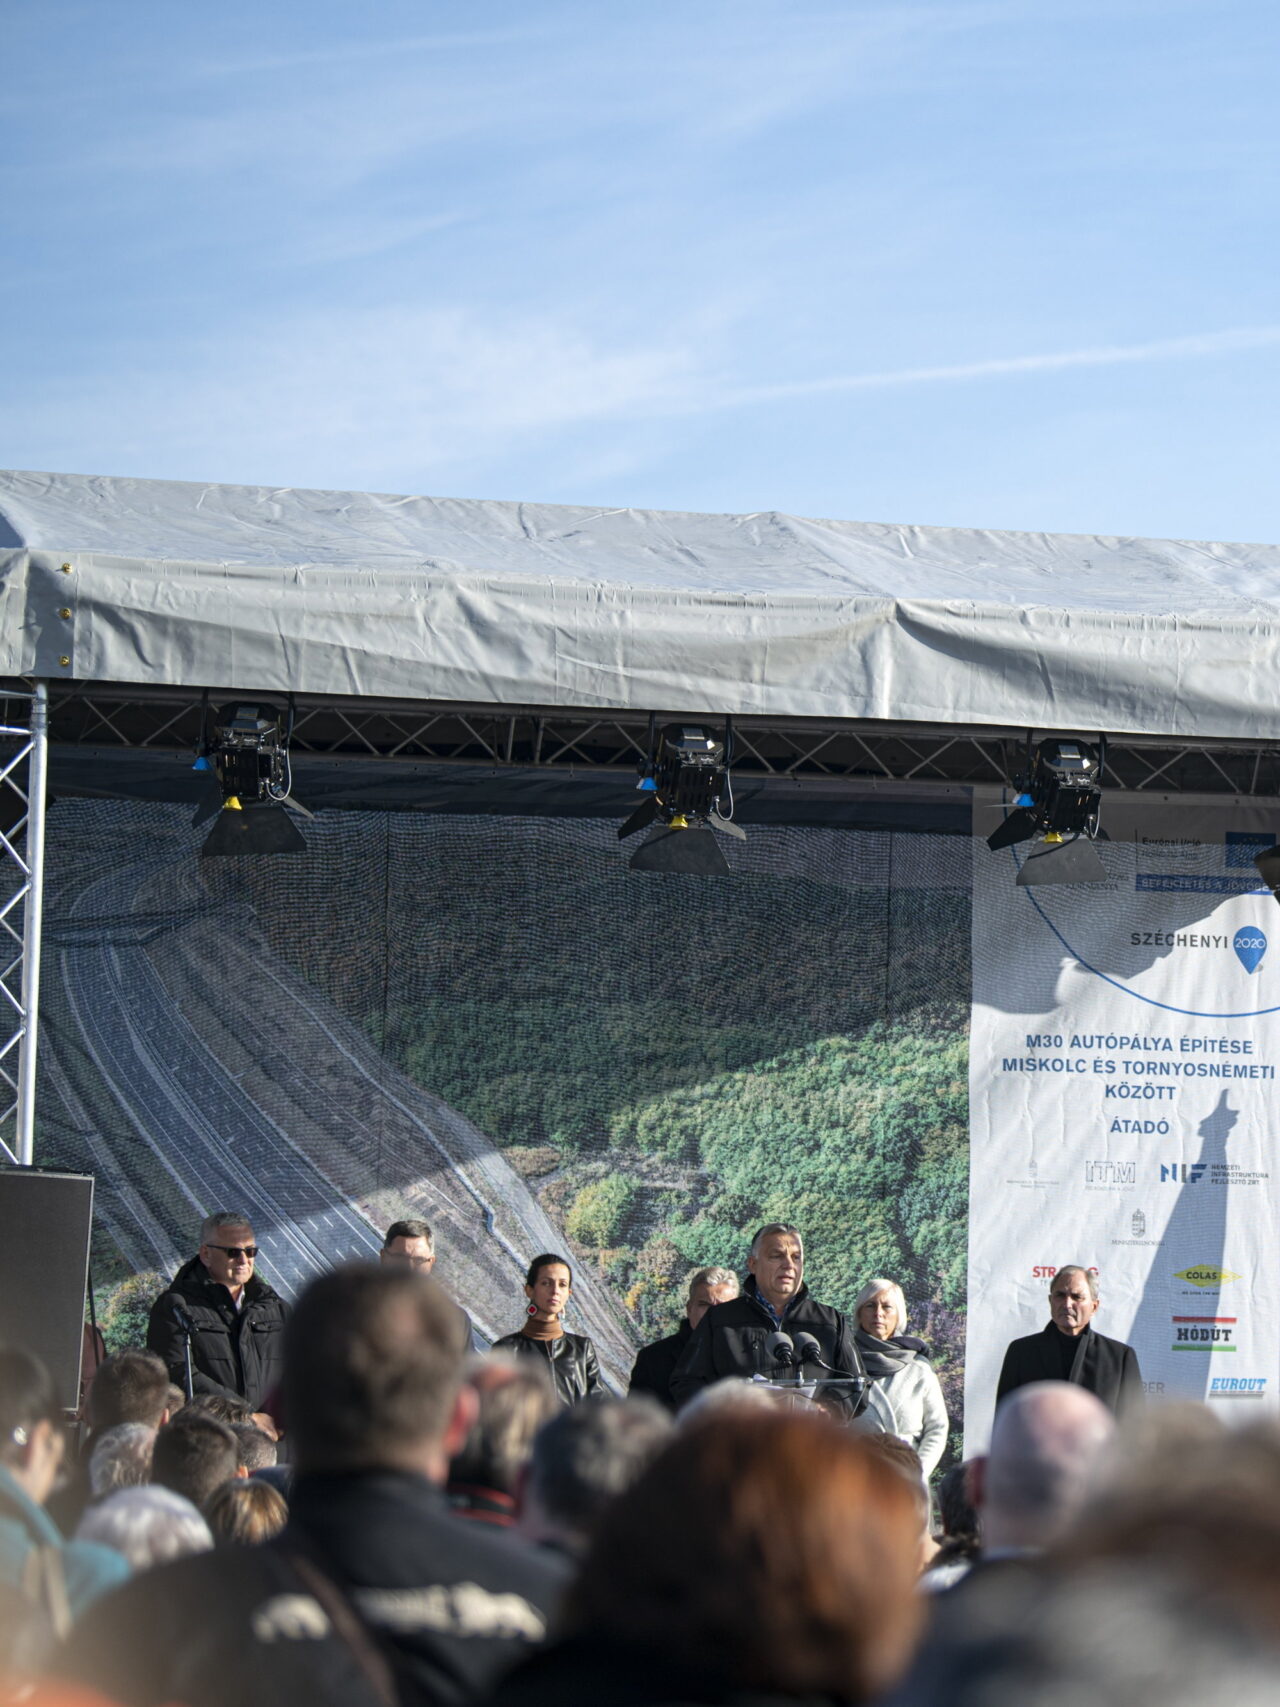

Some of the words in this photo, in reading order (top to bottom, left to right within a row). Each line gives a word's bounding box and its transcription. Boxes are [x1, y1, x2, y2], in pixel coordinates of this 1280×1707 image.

[1130, 930, 1229, 949] SZÉCHENYI
[1234, 937, 1267, 949] 2020
[1026, 1034, 1063, 1048] M30
[1070, 1032, 1173, 1052] AUTÓPÁLYA
[1180, 1035, 1254, 1055] ÉPÍTÉSE
[1002, 1058, 1087, 1073] MISKOLC
[1093, 1056, 1116, 1074] ÉS
[1122, 1060, 1275, 1080] TORNYOSNÉMETI
[1105, 1081, 1177, 1100] KÖZÖTT
[1110, 1115, 1170, 1135] ÁTADÓ
[1085, 1160, 1136, 1183] ITM
[1160, 1163, 1208, 1184] NIF
[1186, 1271, 1218, 1280] COLAS
[1177, 1325, 1232, 1342] HÓDÚT
[1210, 1377, 1267, 1391] EUROUT
